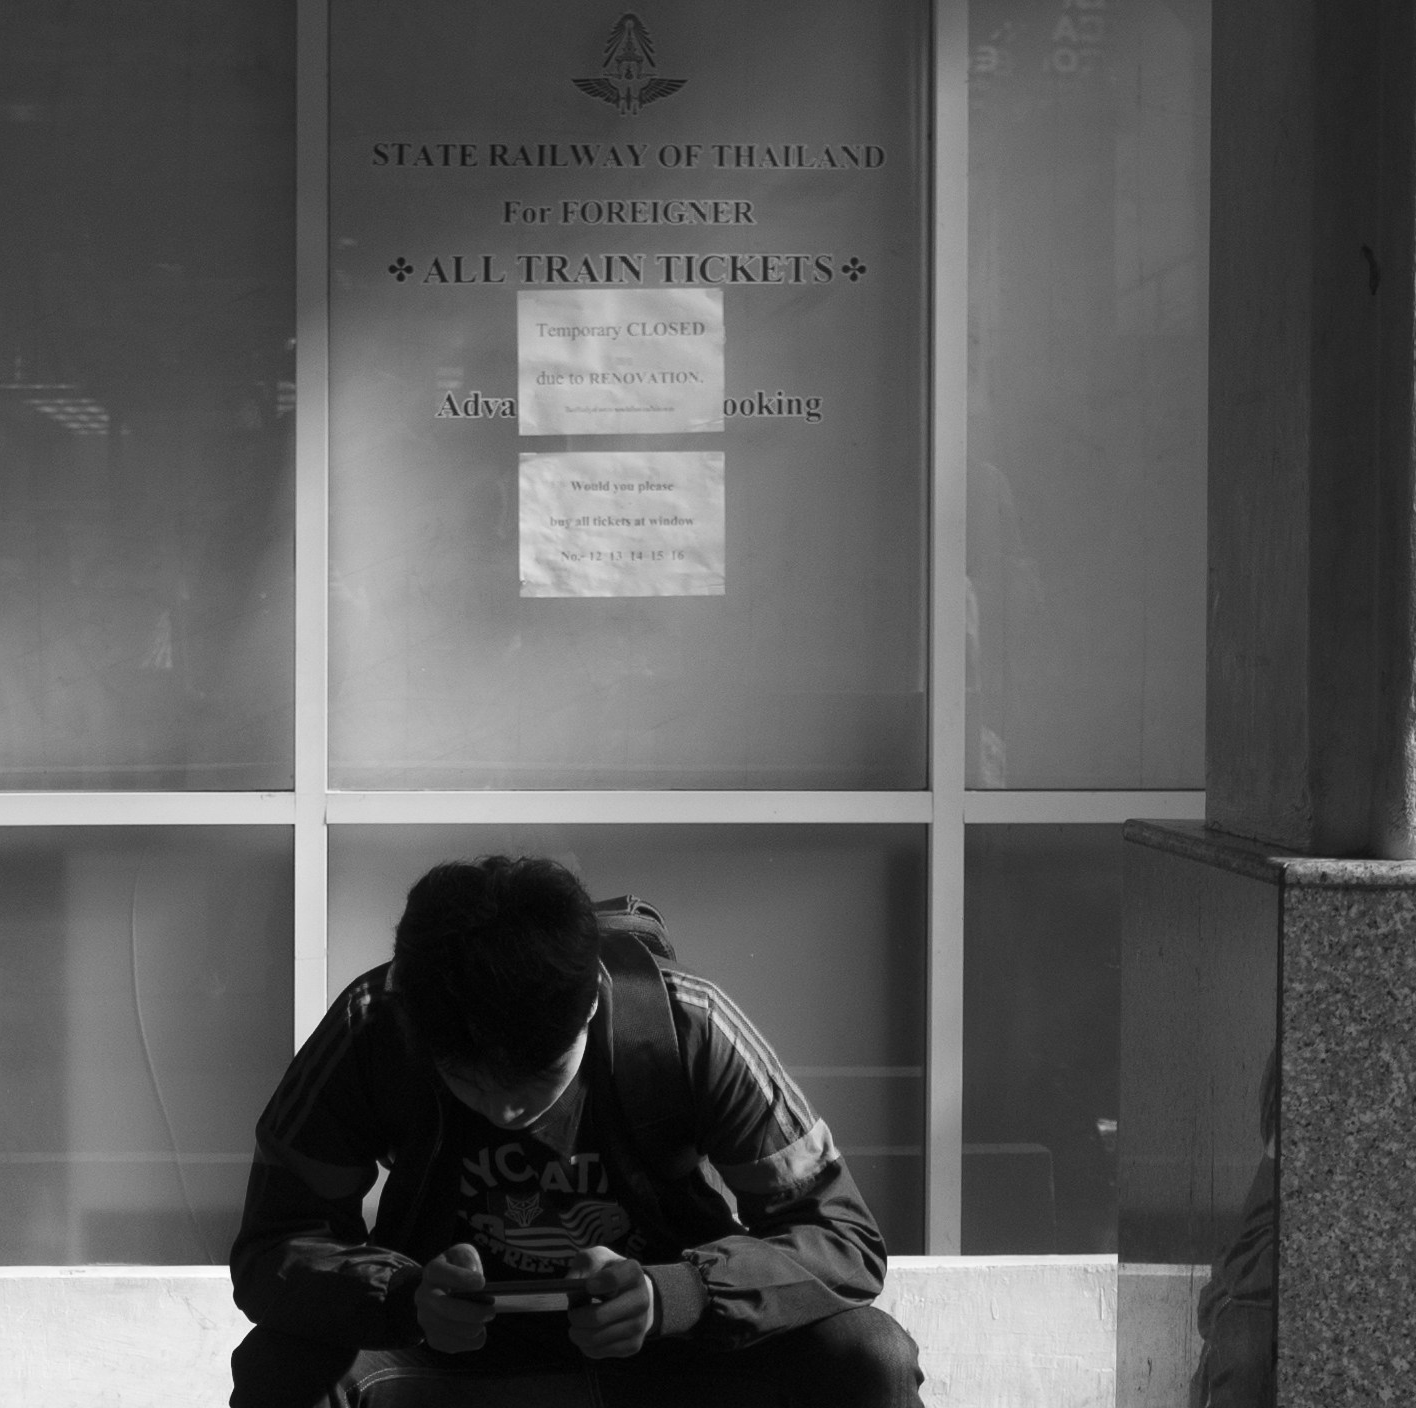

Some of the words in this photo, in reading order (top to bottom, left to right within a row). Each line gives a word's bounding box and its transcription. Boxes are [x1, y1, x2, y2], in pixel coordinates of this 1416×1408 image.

[372, 143, 478, 167] STATE
[488, 144, 648, 168] RAILWAY
[658, 144, 702, 168] OF
[711, 145, 885, 169] THAILAND
[502, 201, 552, 224] For
[561, 201, 757, 224] FOREIGNER
[423, 255, 506, 284] ALL
[516, 255, 644, 284] TRAIN
[656, 255, 833, 284] TICKETS
[536, 322, 622, 341] Temporary
[626, 321, 706, 337] CLOSED
[536, 371, 565, 386] due
[569, 372, 584, 386] to
[589, 371, 704, 385] RENOVATION.
[436, 392, 517, 418] Adva
[722, 391, 823, 422] ooking
[570, 480, 610, 492] Would
[613, 483, 635, 495] you
[638, 481, 674, 494] please
[550, 516, 571, 529] buy
[575, 516, 590, 527] all
[593, 516, 631, 527] tickets
[634, 517, 645, 527] at
[648, 516, 694, 527] window
[590, 551, 603, 561] 12
[610, 551, 623, 561] 13
[630, 551, 643, 561] 14
[651, 551, 664, 561] 15
[671, 551, 685, 561] 16
